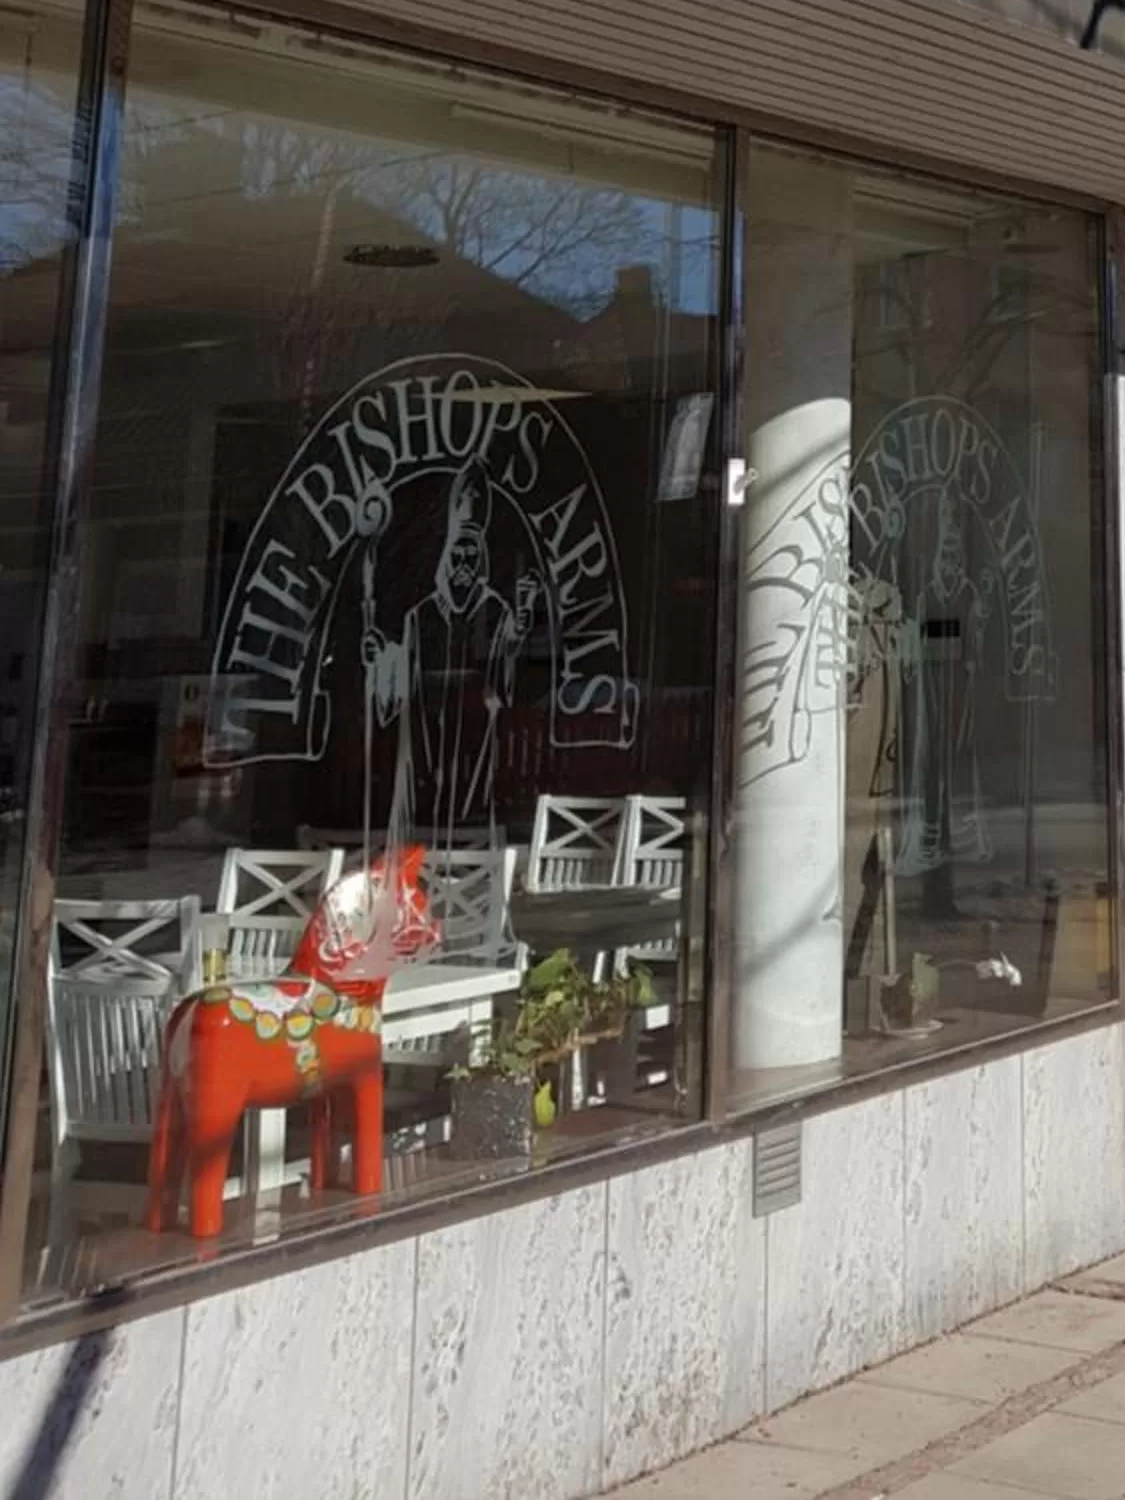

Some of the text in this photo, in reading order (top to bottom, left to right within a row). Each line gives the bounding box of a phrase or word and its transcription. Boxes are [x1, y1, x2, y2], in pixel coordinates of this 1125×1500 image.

[221, 539, 333, 741] THE
[286, 370, 552, 558] BISHOPS
[528, 484, 623, 715] ARMS
[988, 496, 1047, 677] ARMS
